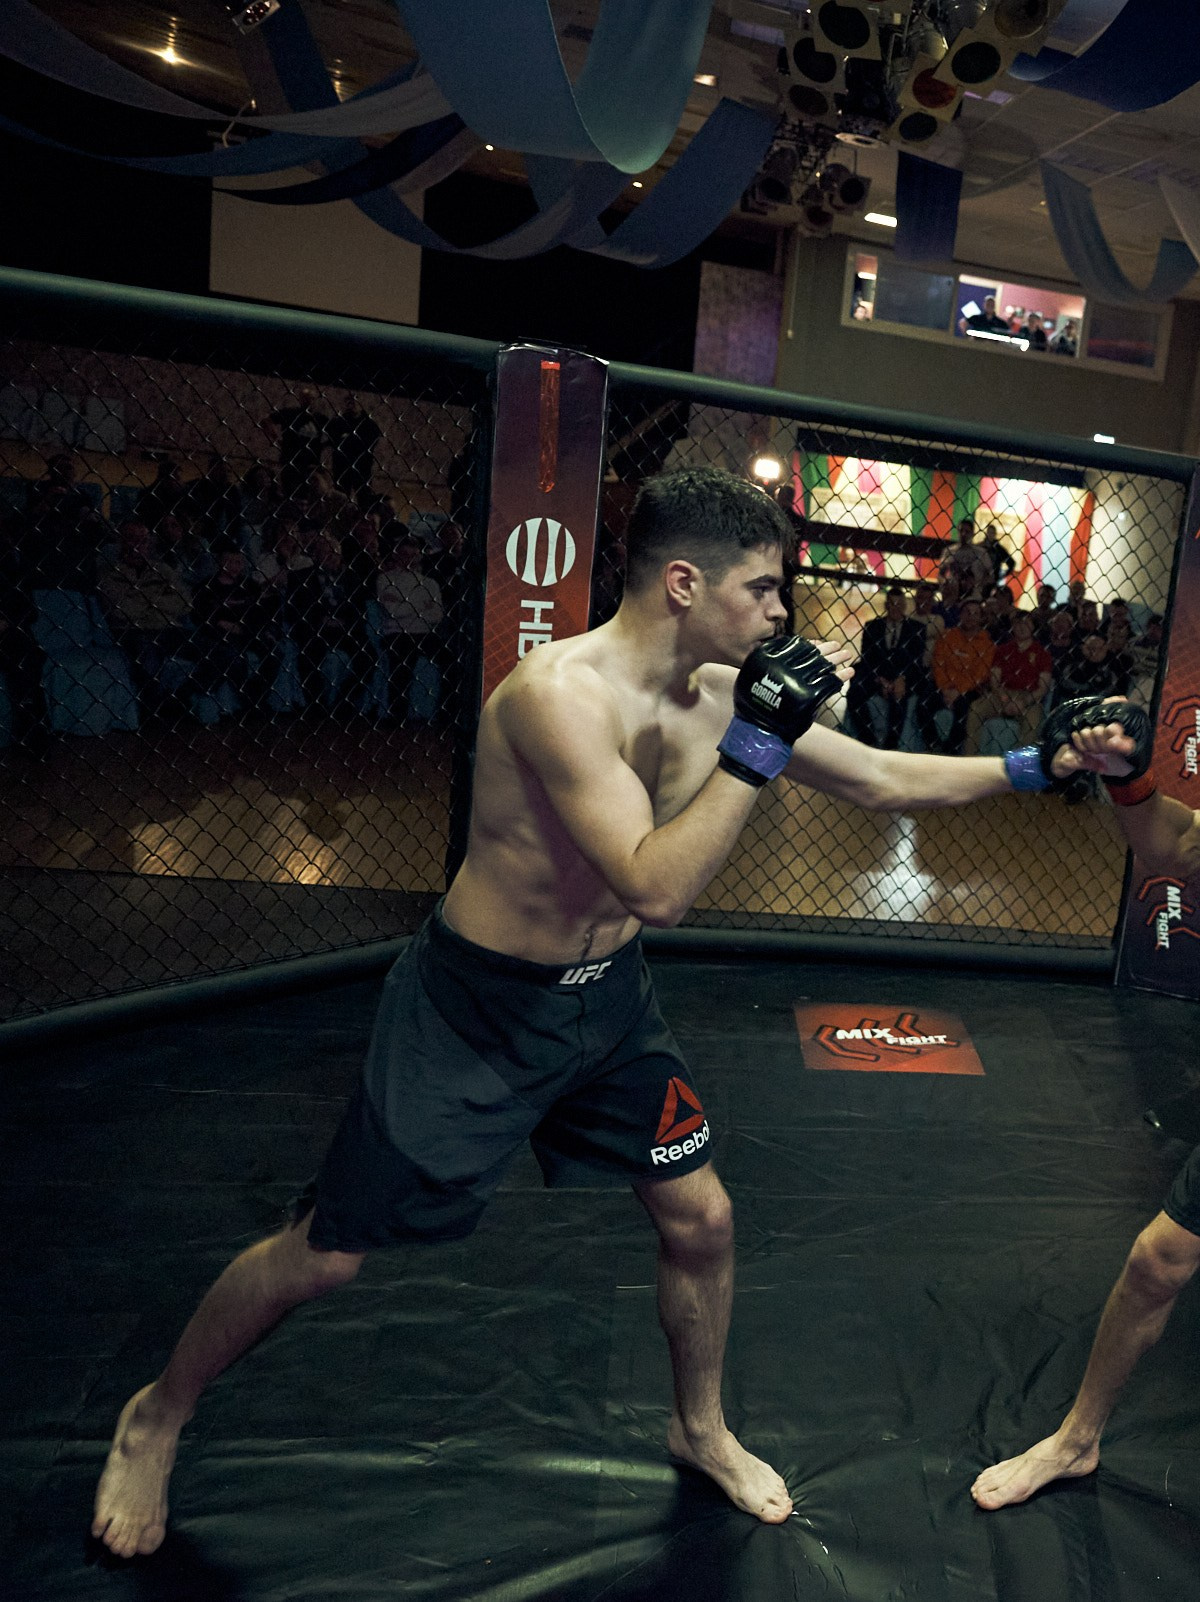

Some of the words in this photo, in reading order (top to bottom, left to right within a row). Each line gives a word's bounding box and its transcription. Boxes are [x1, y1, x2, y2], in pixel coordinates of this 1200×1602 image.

[518, 599, 554, 659] НБ
[750, 682, 782, 710] GORILLA
[1186, 736, 1198, 775] FIGHT
[1167, 886, 1182, 920] MIX
[1158, 912, 1170, 950] FIGHT
[559, 961, 612, 984] UFC
[836, 1028, 894, 1039] MIX
[886, 1035, 947, 1046] FIGHT
